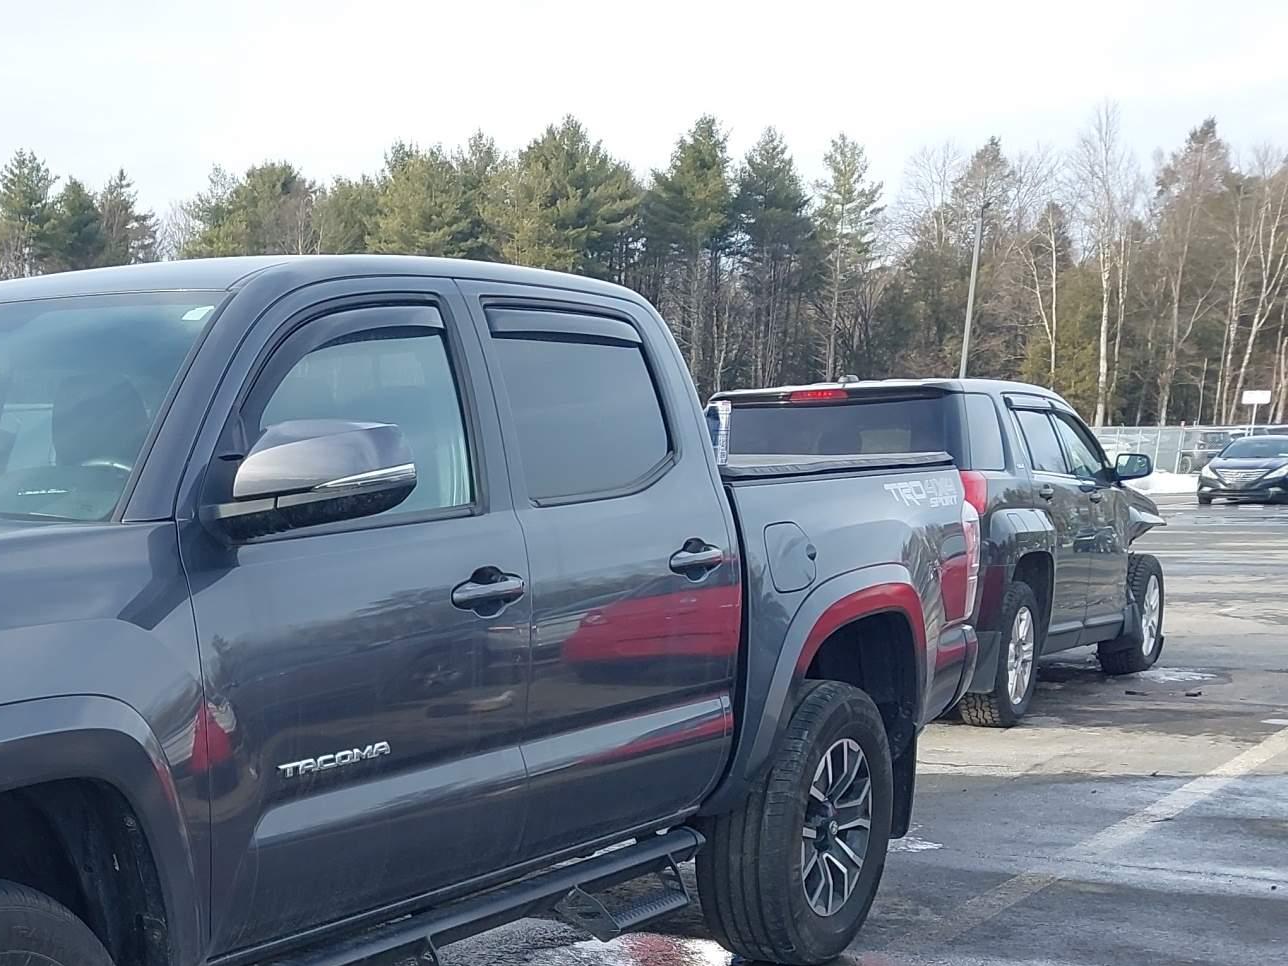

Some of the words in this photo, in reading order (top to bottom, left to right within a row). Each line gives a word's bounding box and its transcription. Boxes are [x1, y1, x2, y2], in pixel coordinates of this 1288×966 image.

[883, 480, 927, 507] TRD
[929, 495, 958, 508] SPORT
[278, 741, 391, 777] TACOMA
